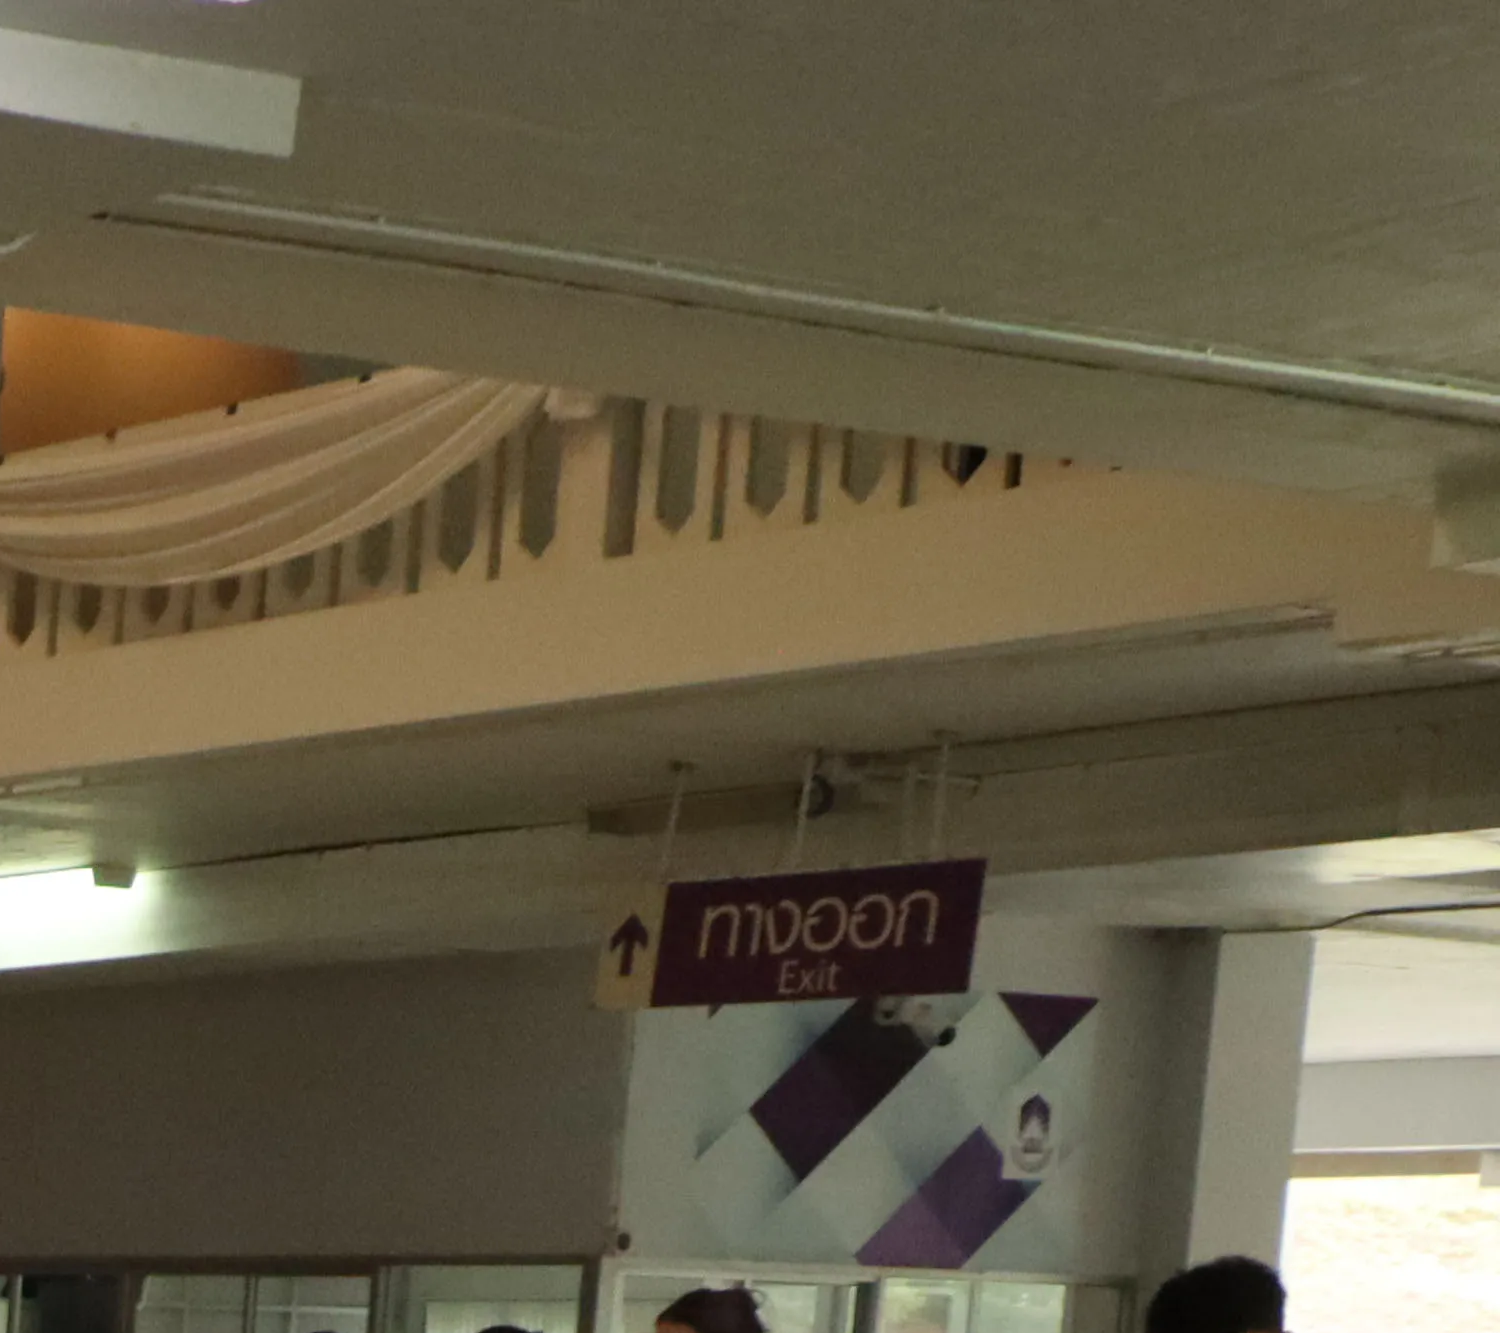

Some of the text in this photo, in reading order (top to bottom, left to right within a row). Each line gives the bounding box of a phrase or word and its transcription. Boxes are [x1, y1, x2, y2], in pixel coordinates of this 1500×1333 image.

[697, 887, 940, 959] ทางออก
[778, 958, 841, 995] Exit
